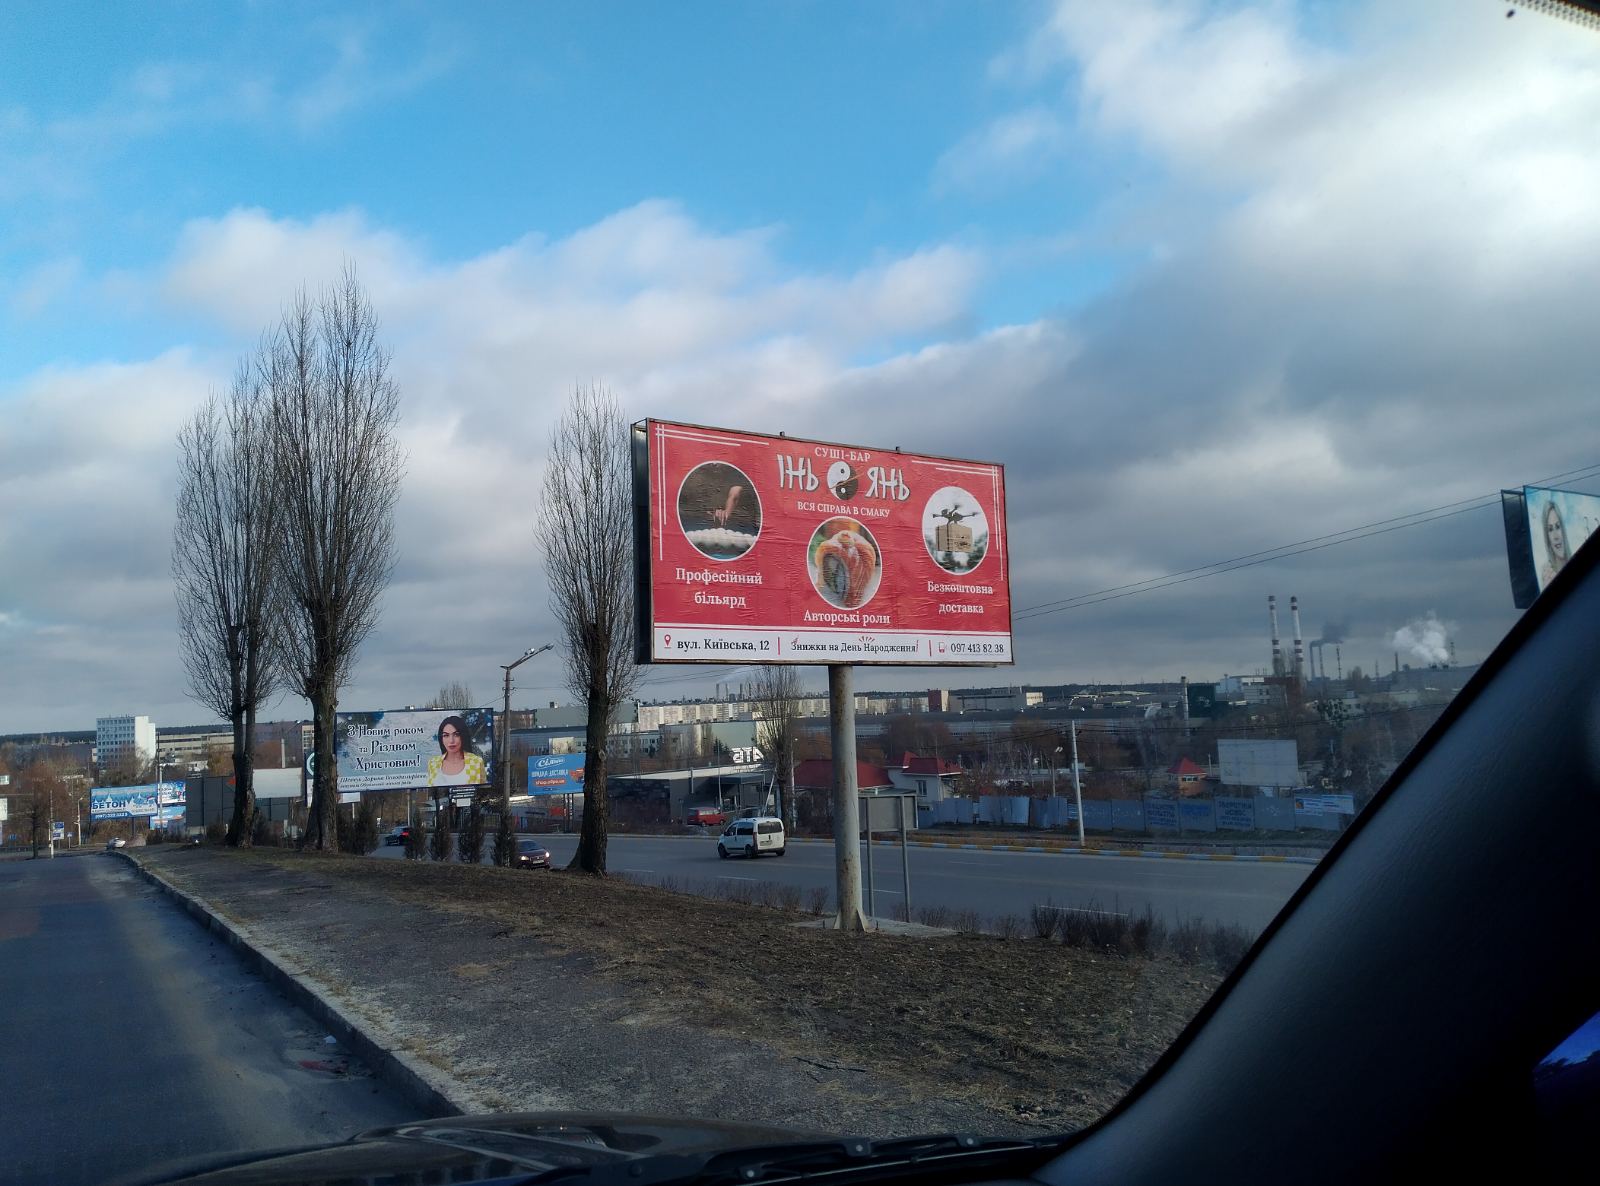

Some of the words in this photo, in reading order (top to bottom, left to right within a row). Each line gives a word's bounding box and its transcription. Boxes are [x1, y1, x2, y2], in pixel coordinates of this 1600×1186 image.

[814, 447, 871, 462] СУШІ-БАР
[776, 453, 819, 491] ІНЬ
[865, 465, 911, 501] ЯНЬ
[797, 501, 816, 512] ВСЯ
[817, 503, 852, 514] СПРАВА
[853, 506, 859, 514] В
[860, 507, 891, 517] СМАКУ
[675, 567, 763, 585] Професійний
[927, 581, 994, 594] Безкоштовна
[694, 591, 747, 609] більярд
[938, 604, 985, 615] доставка
[803, 610, 861, 625] Авторські
[862, 614, 891, 626] роли
[677, 641, 701, 652] вул.
[703, 639, 757, 651] Київська,
[759, 640, 770, 650] 12
[791, 642, 827, 651] Знижки
[840, 643, 862, 653] День
[863, 643, 916, 654] Народження
[950, 643, 966, 653] 097
[967, 643, 981, 653] 413
[982, 644, 993, 653] 82
[994, 644, 1004, 653] 38
[358, 724, 391, 738] Новим
[393, 727, 424, 737] роком
[370, 740, 417, 756] Різдвом
[356, 754, 421, 772] Христовим!
[92, 800, 126, 810] БЕТОН
